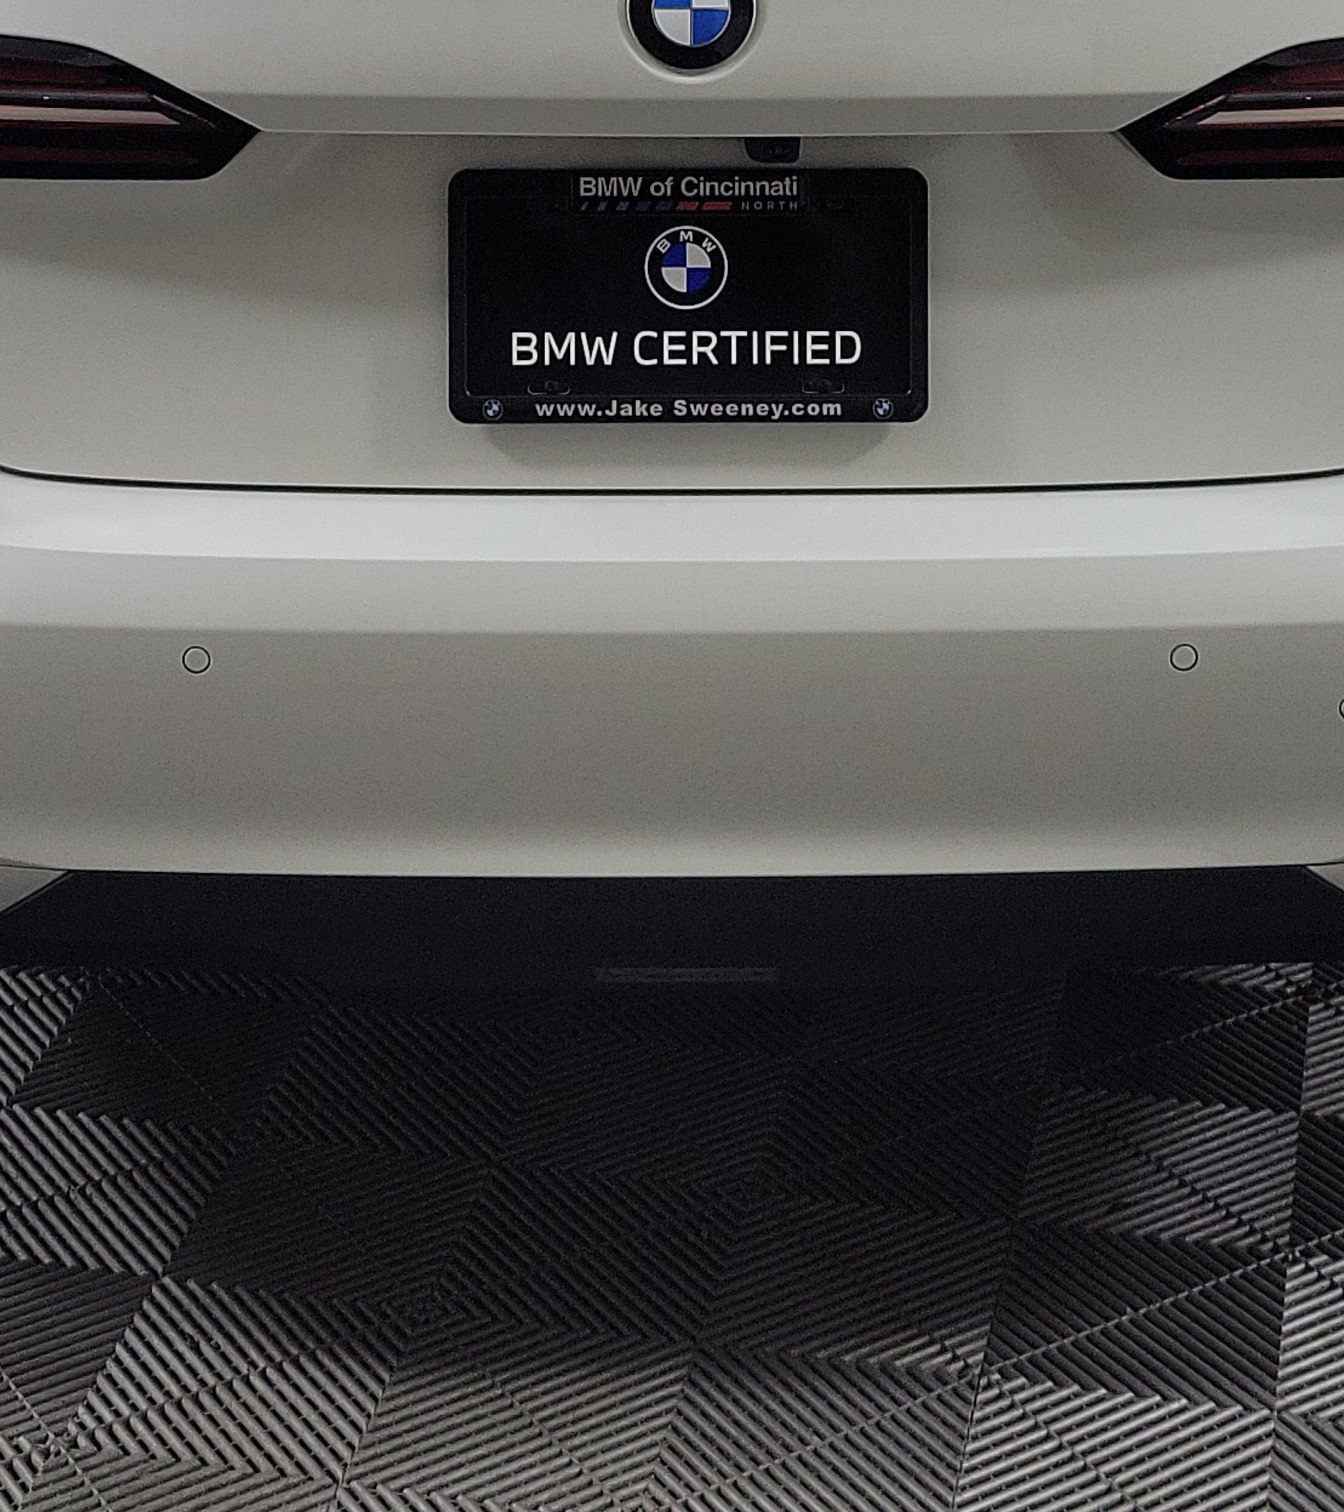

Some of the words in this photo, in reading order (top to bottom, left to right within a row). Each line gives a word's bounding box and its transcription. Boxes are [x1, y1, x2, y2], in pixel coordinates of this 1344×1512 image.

[579, 176, 643, 197] BMW
[649, 176, 674, 197] of
[680, 175, 798, 197] Cincinnati
[741, 200, 798, 210] NORTH
[656, 231, 717, 254] BMW
[511, 332, 618, 366] BMW
[633, 331, 862, 366] CERTIFIED
[535, 400, 663, 418] www.Jake
[673, 400, 843, 420] Sweeney.com
